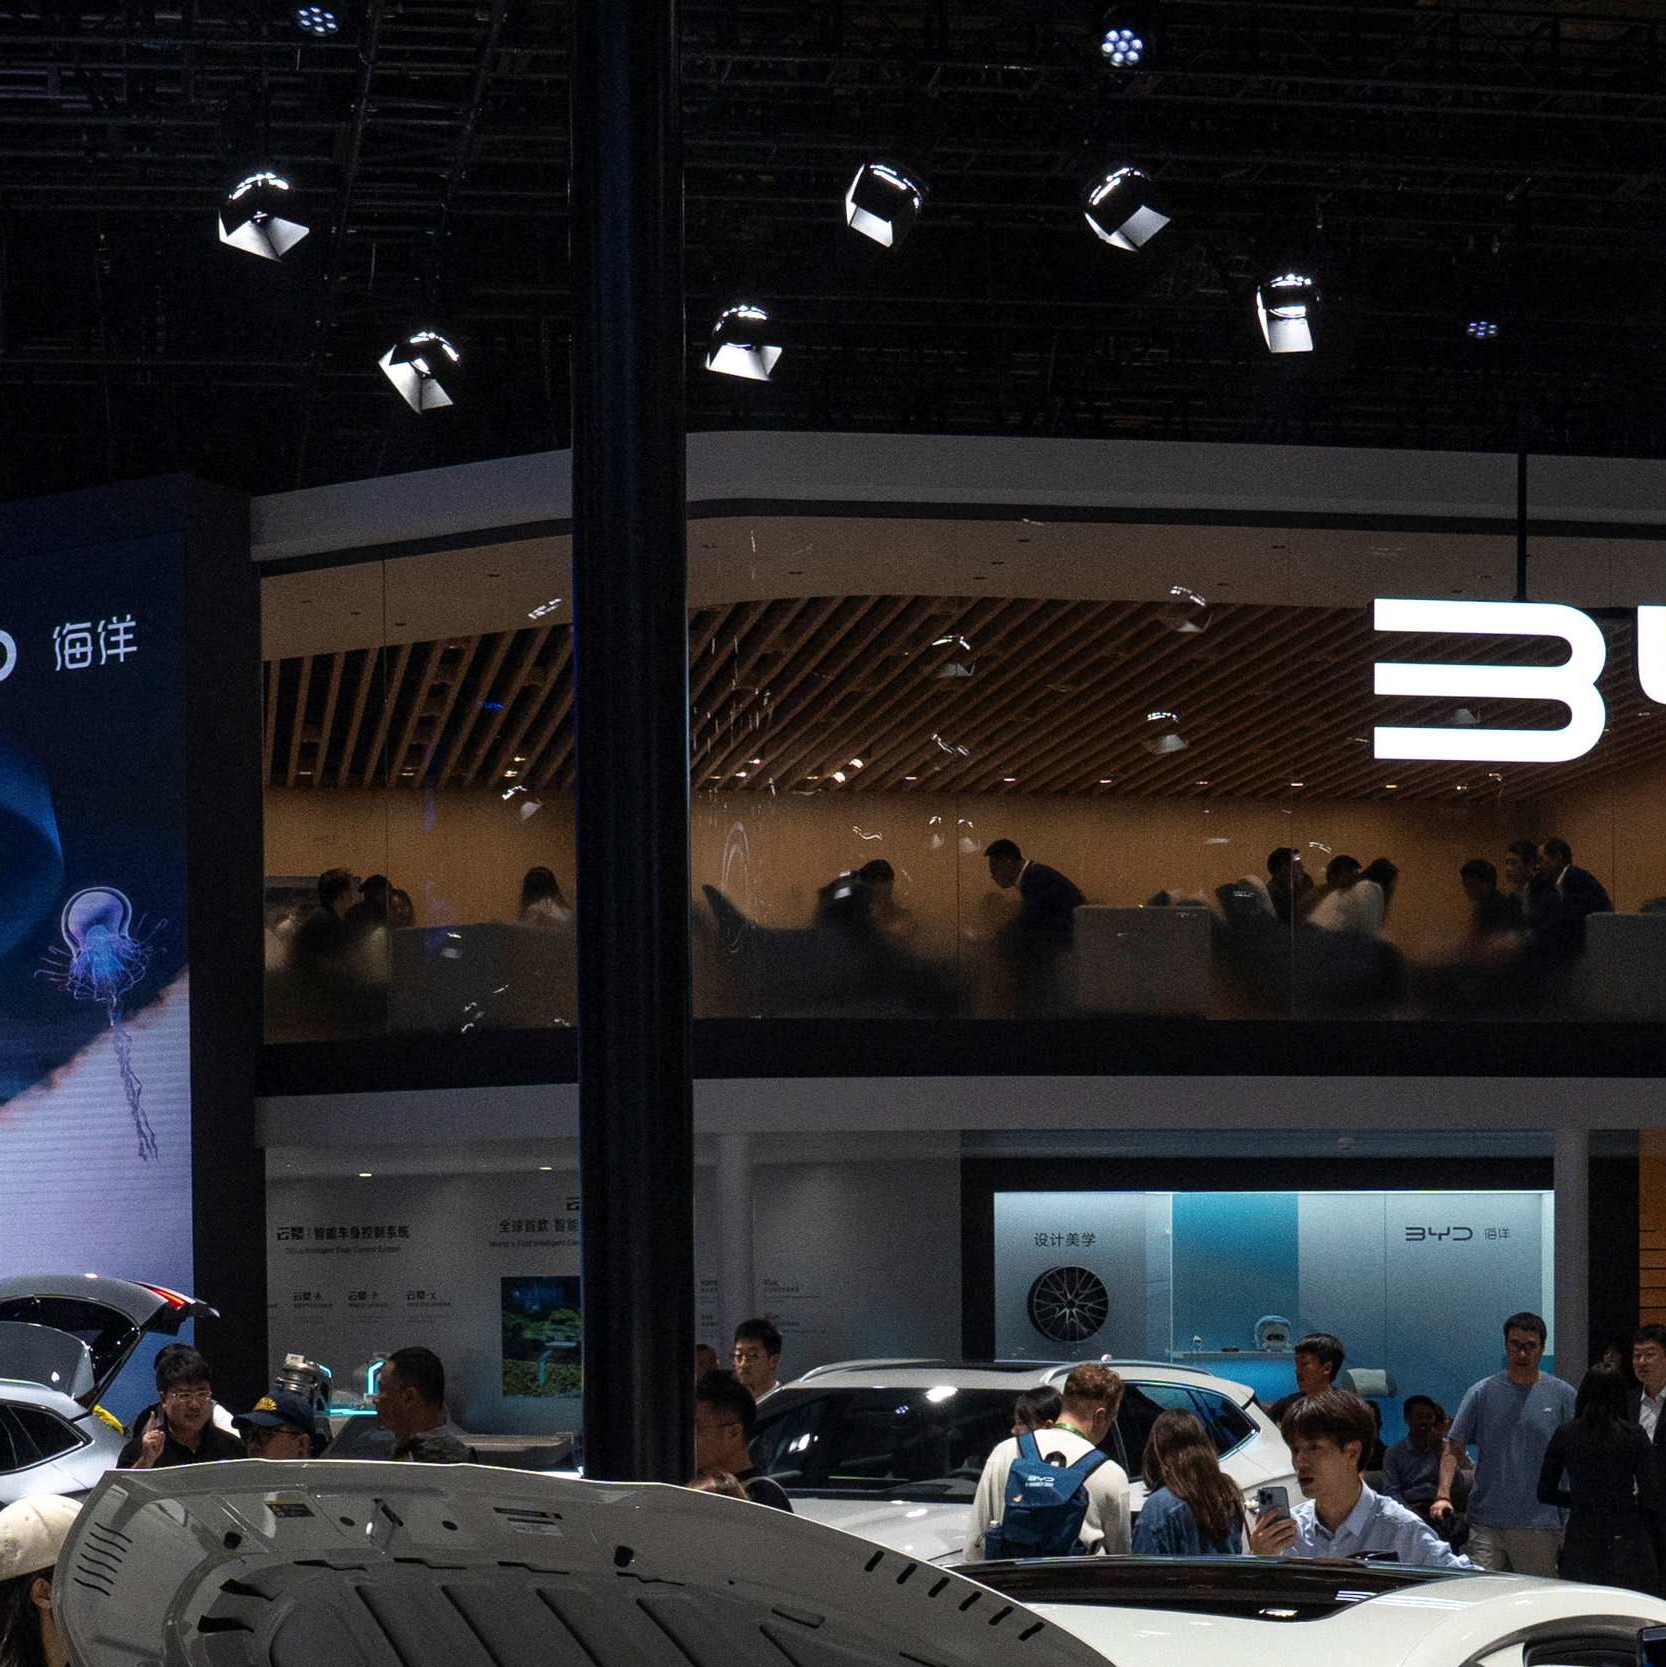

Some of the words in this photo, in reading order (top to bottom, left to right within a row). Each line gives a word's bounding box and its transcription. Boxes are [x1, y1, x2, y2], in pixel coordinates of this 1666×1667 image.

[52, 614, 138, 671] 海洋
[1034, 1231, 1096, 1248] 设计美学
[1405, 1226, 1473, 1242] BYD
